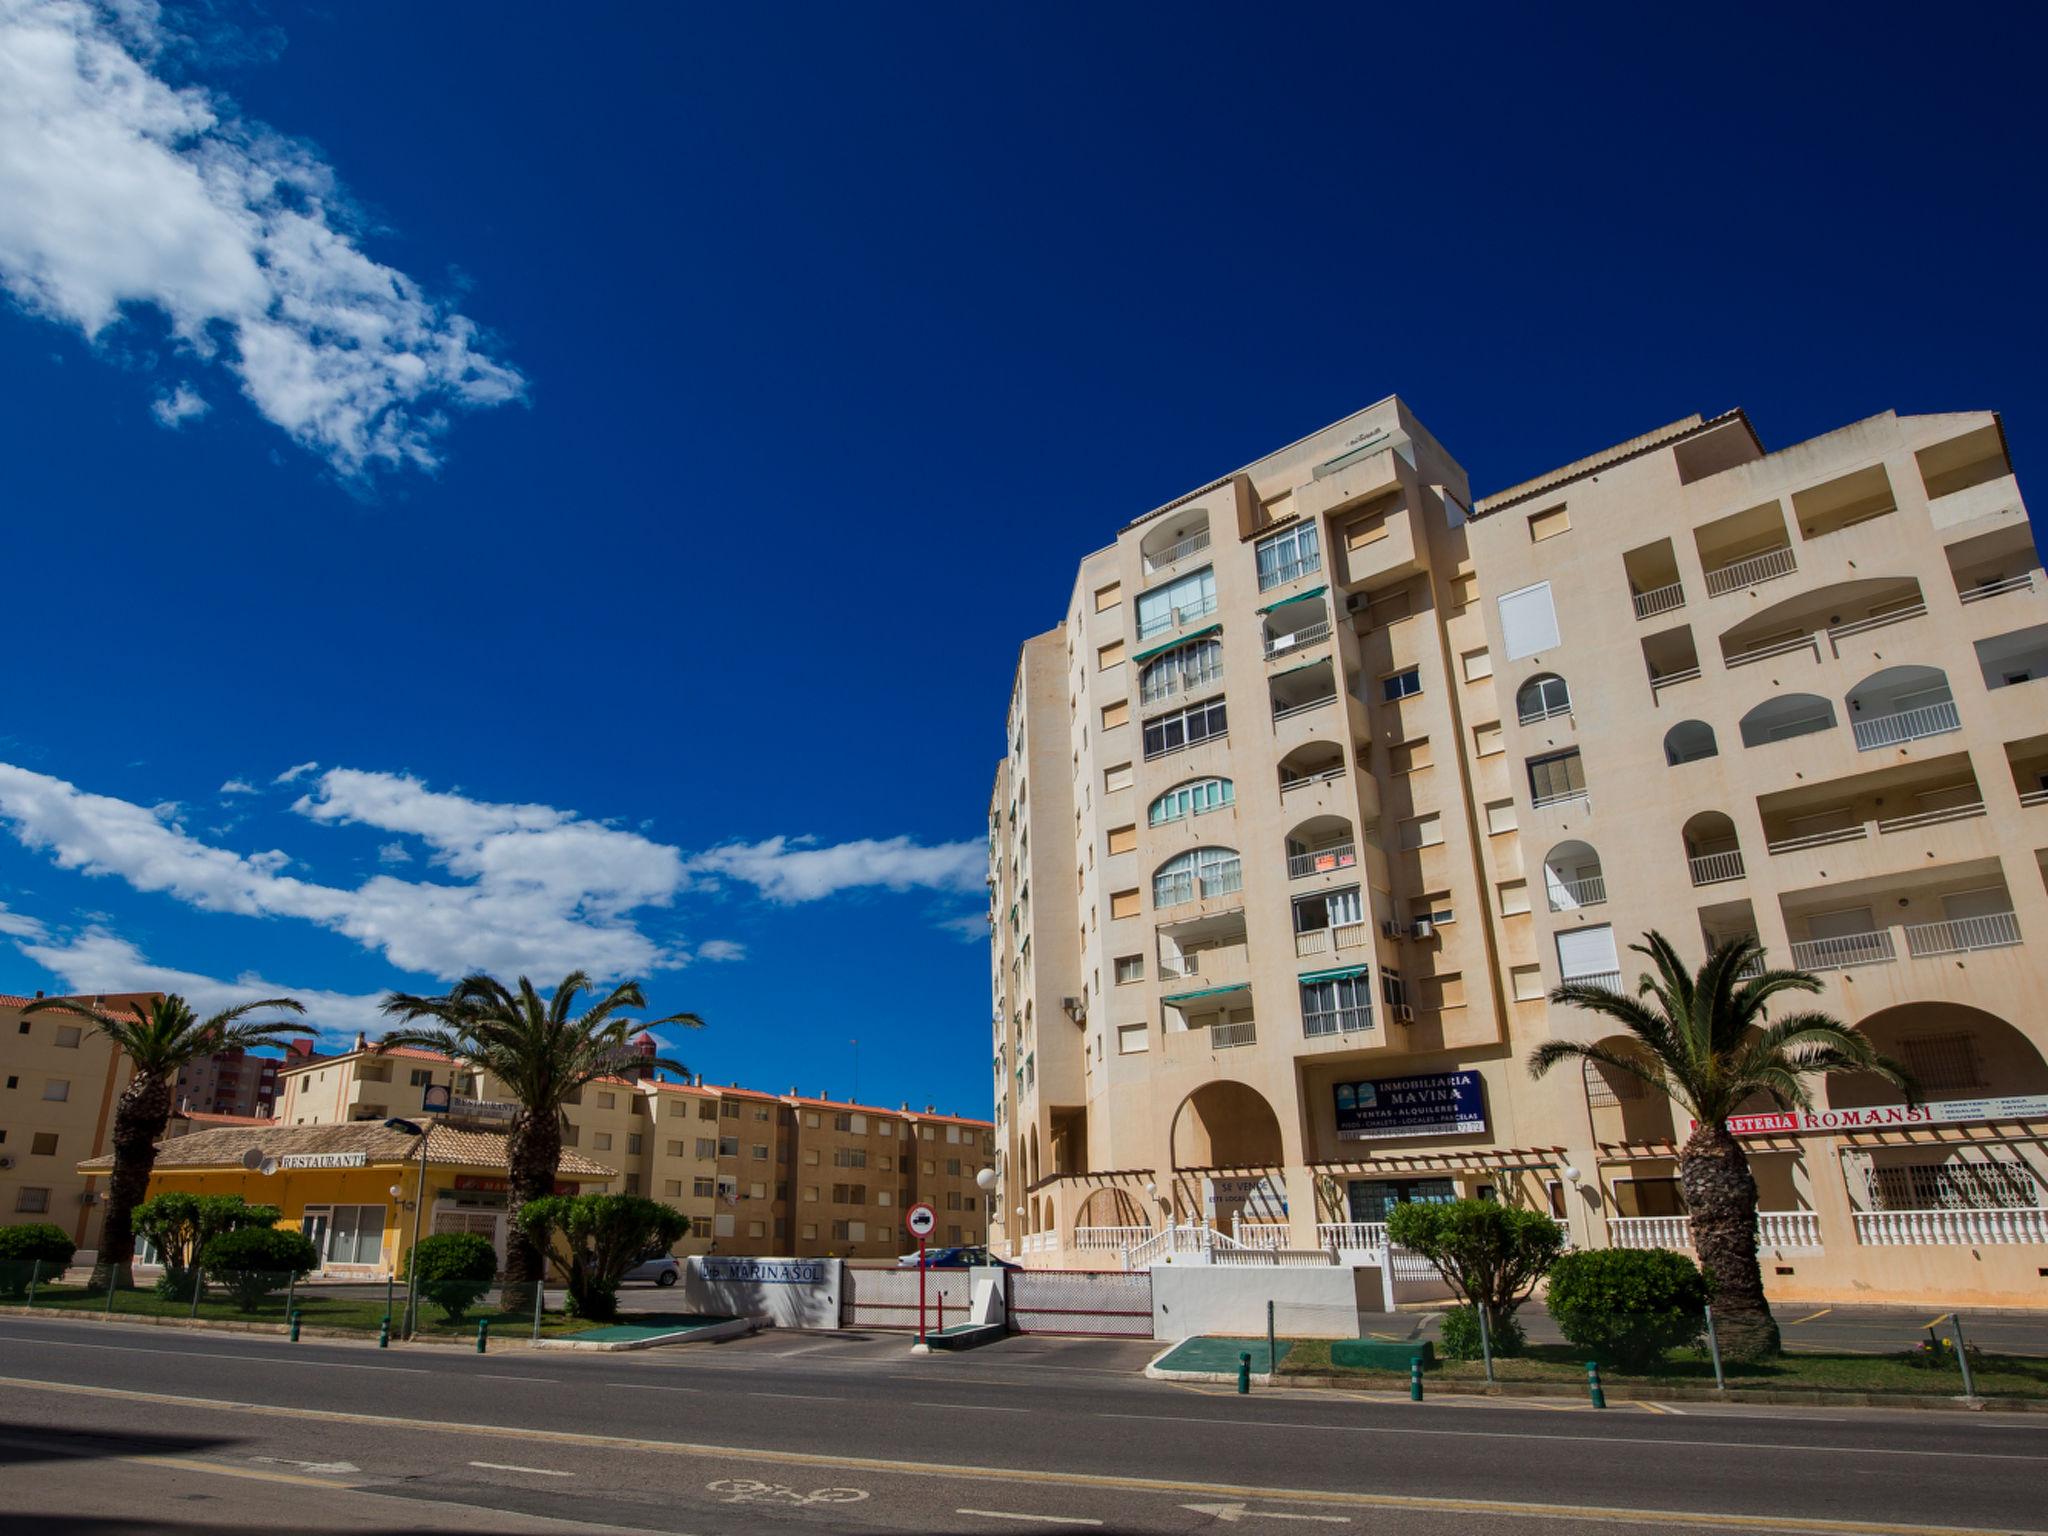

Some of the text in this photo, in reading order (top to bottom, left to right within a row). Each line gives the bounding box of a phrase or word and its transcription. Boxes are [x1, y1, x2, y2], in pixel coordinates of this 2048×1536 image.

[1380, 1076, 1471, 1092] INMOBILIARIA
[1391, 1088, 1463, 1105] MAVINA
[1356, 1103, 1459, 1119] VENTAS ALQUILERES
[1804, 1105, 1933, 1129] ROMANSI
[1365, 1119, 1397, 1128] CHALETS
[1402, 1116, 1435, 1125] LOCALES
[1441, 1113, 1478, 1121] PARCELAS
[1725, 1115, 1794, 1132] RETERIA
[1222, 1181, 1268, 1192] SE VENDE
[1209, 1195, 1223, 1203] ESTE
[730, 1263, 820, 1281] MARINASOL
